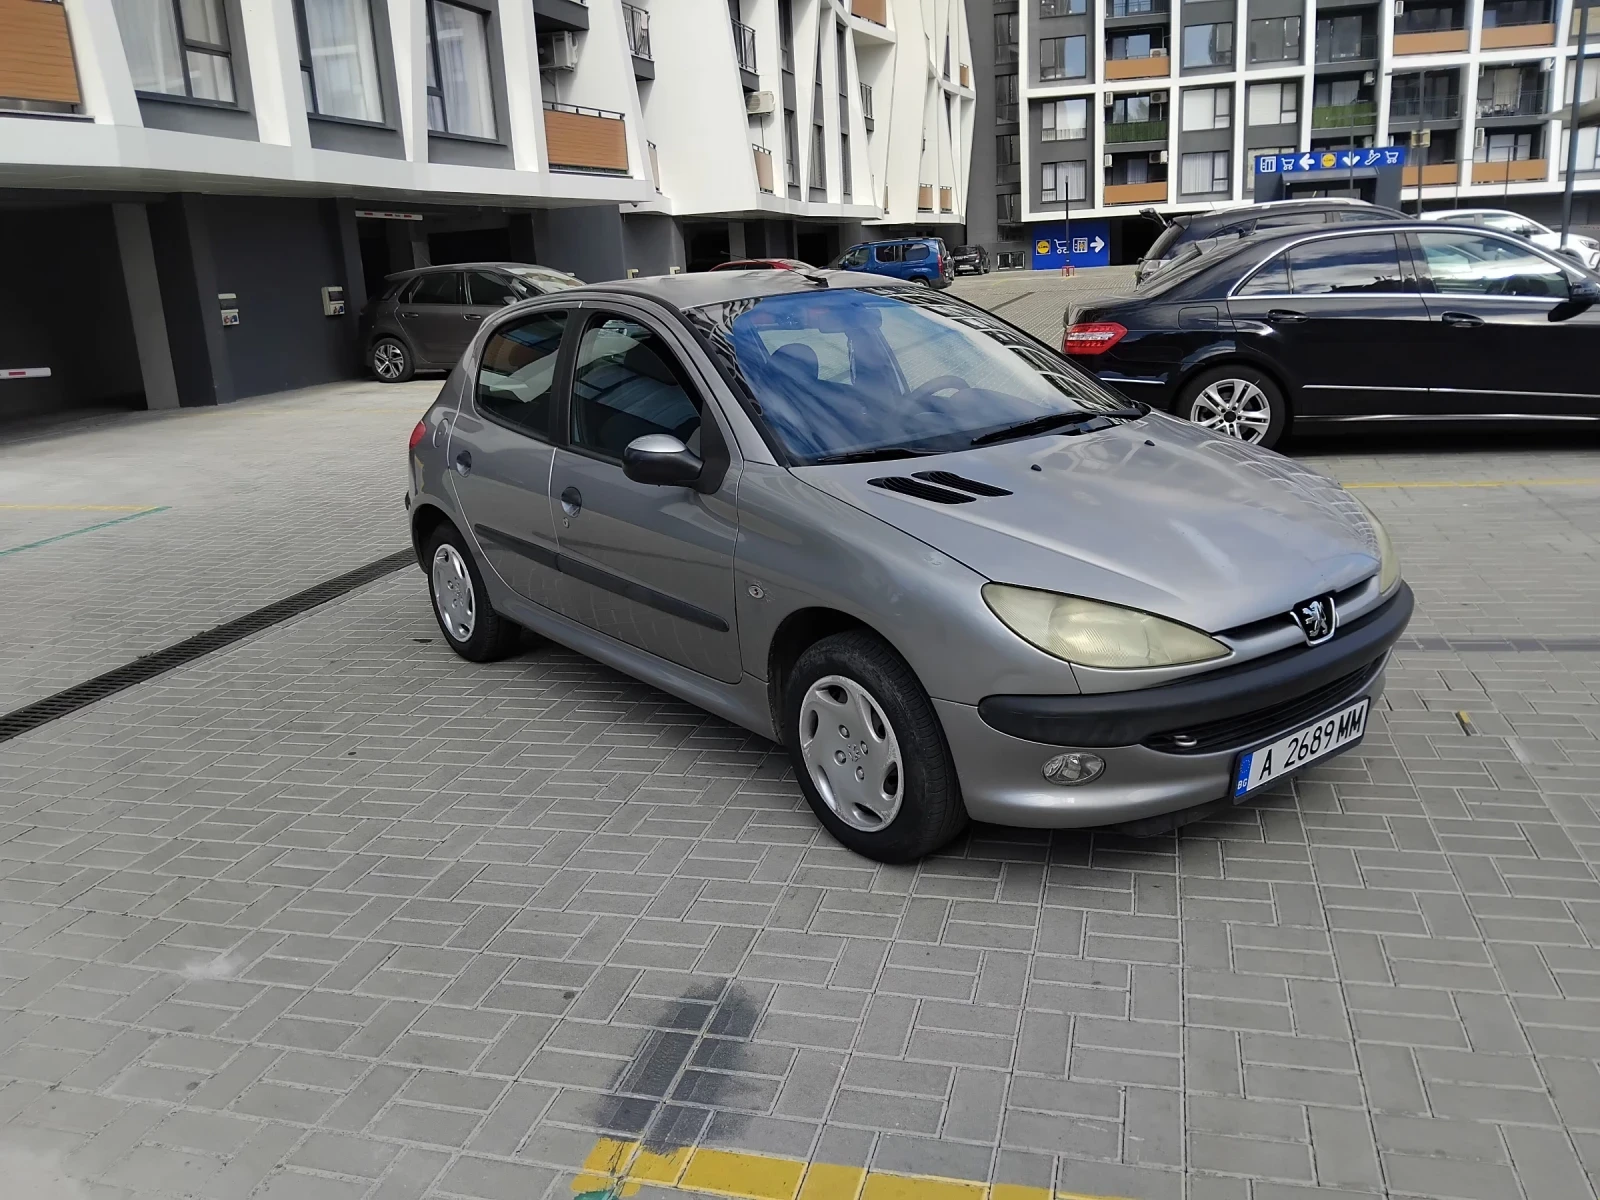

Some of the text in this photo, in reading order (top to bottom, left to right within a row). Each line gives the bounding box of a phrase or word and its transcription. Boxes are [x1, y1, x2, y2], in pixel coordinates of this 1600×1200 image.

[1259, 704, 1365, 780] A 2689 MM
[1237, 778, 1248, 790] BG
